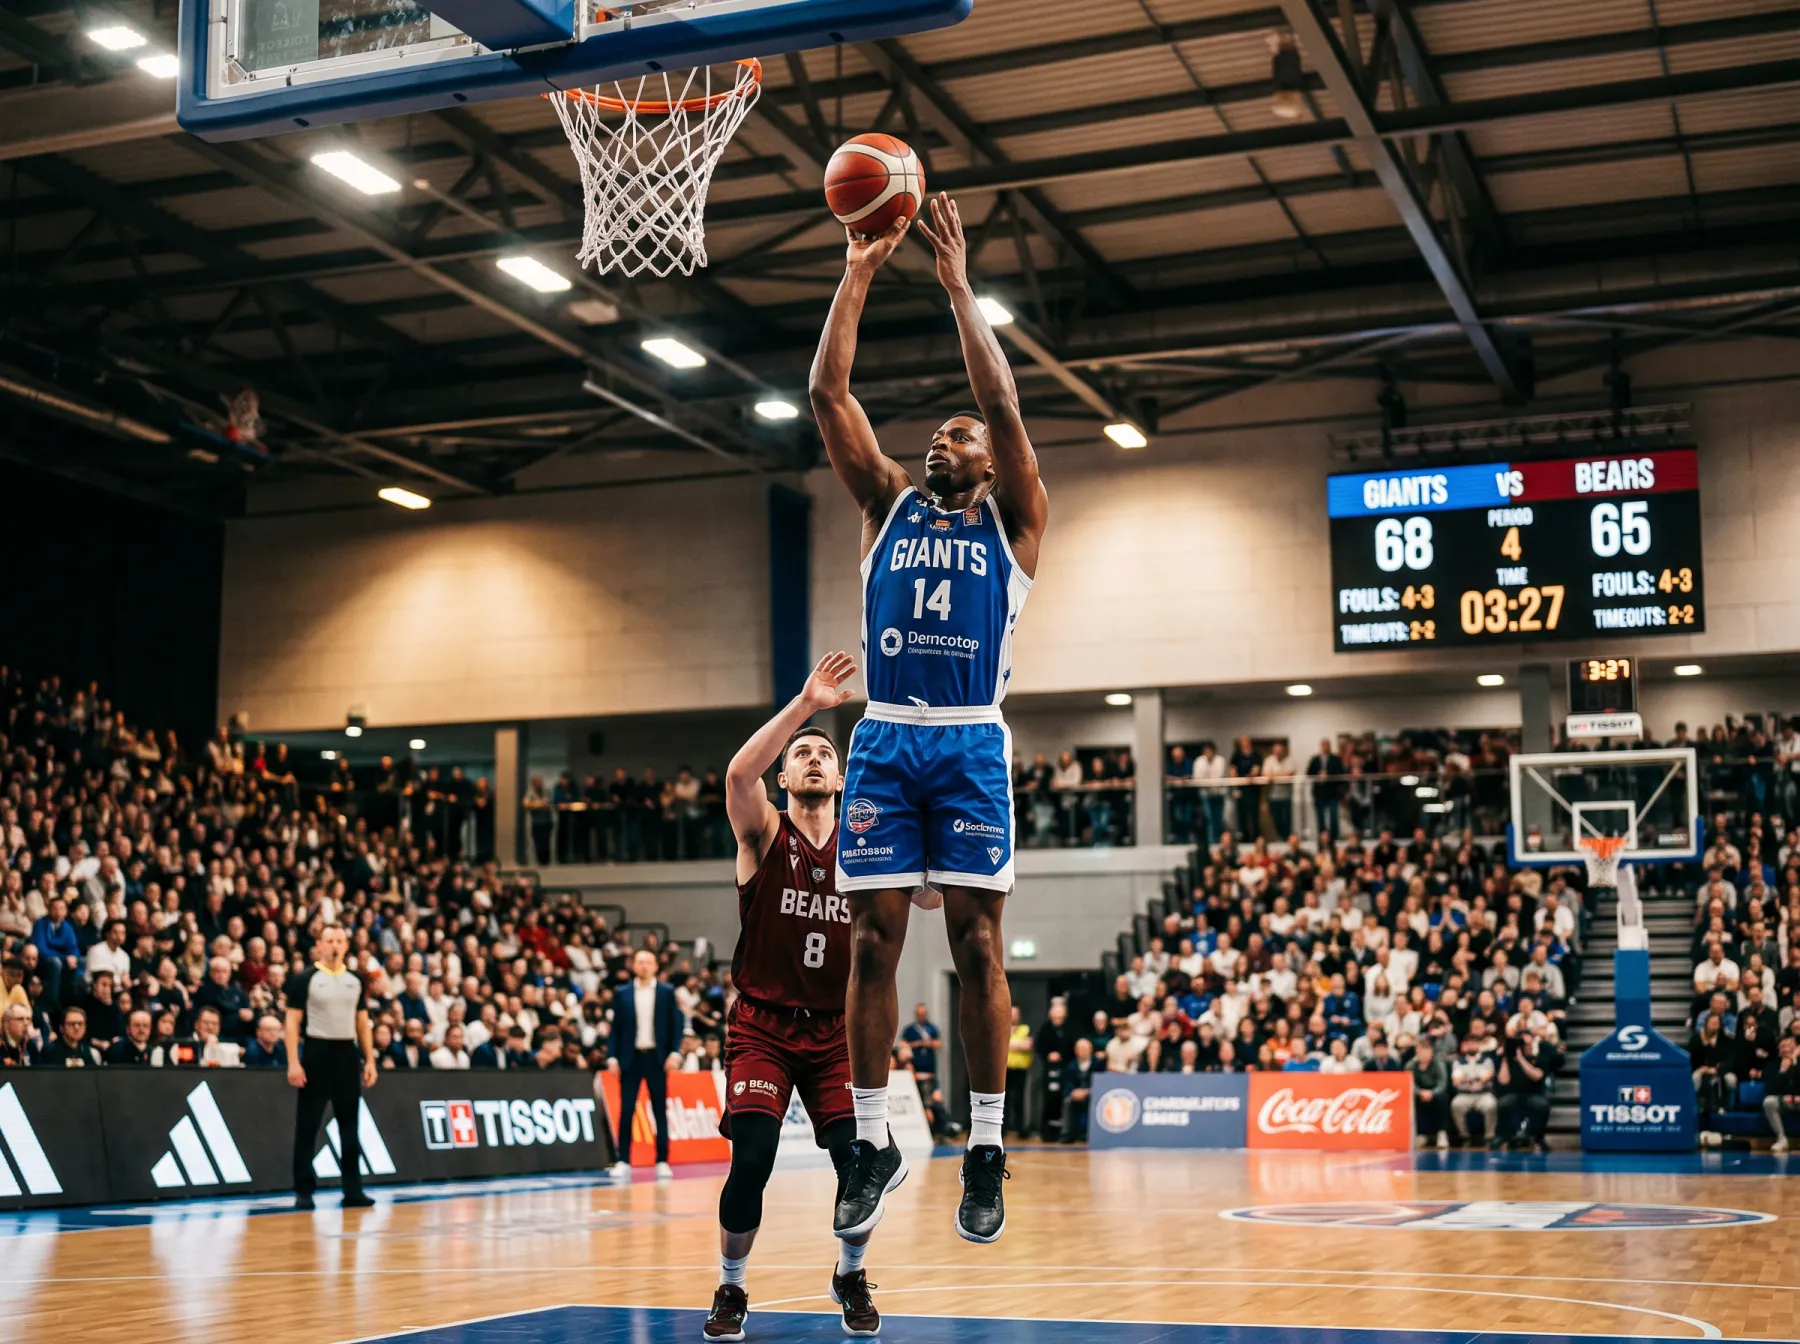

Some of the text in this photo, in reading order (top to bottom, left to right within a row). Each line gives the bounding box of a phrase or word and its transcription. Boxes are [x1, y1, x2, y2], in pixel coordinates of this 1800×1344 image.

[1363, 457, 1655, 509] GIANTS VS BEARS
[1374, 516, 1434, 572] 68
[1500, 526, 1522, 561] 4
[1590, 500, 1652, 558] 65
[889, 537, 988, 577] GIANTS
[1496, 567, 1529, 586] TIME
[1592, 567, 1694, 598] FOULS: 4-3
[913, 577, 951, 621] 14
[1339, 583, 1435, 614] FOULS: 4-3
[1460, 584, 1565, 635] 03:27
[1593, 605, 1694, 630] TIMEOUTS: 2-2
[1588, 659, 1630, 681] 3:27
[780, 888, 851, 924] BEARS
[803, 932, 827, 969] 8
[749, 1079, 778, 1095] BEARS
[474, 1097, 596, 1147] TISSOT
[1590, 1105, 1681, 1124] TISSOT
